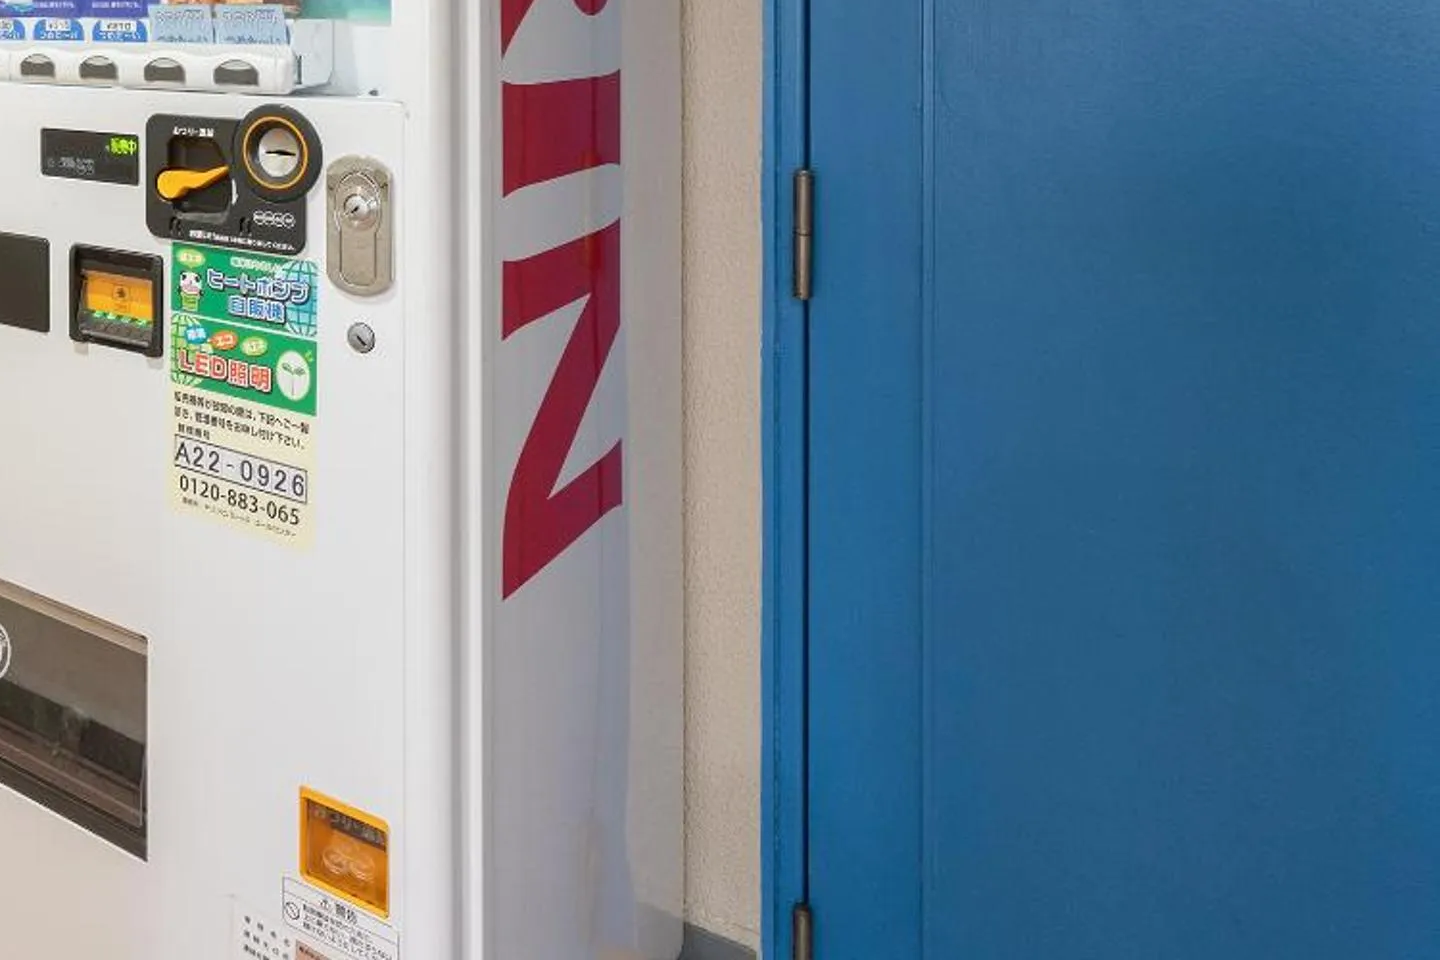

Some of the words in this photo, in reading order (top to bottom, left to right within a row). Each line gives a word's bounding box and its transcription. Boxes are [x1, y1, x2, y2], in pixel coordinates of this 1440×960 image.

[207, 268, 310, 305] ヒートポンプ
[228, 295, 286, 324] 自販機
[178, 348, 273, 393] LED照明
[174, 441, 305, 497] A22-0926
[179, 474, 301, 526] 0120-883-065
